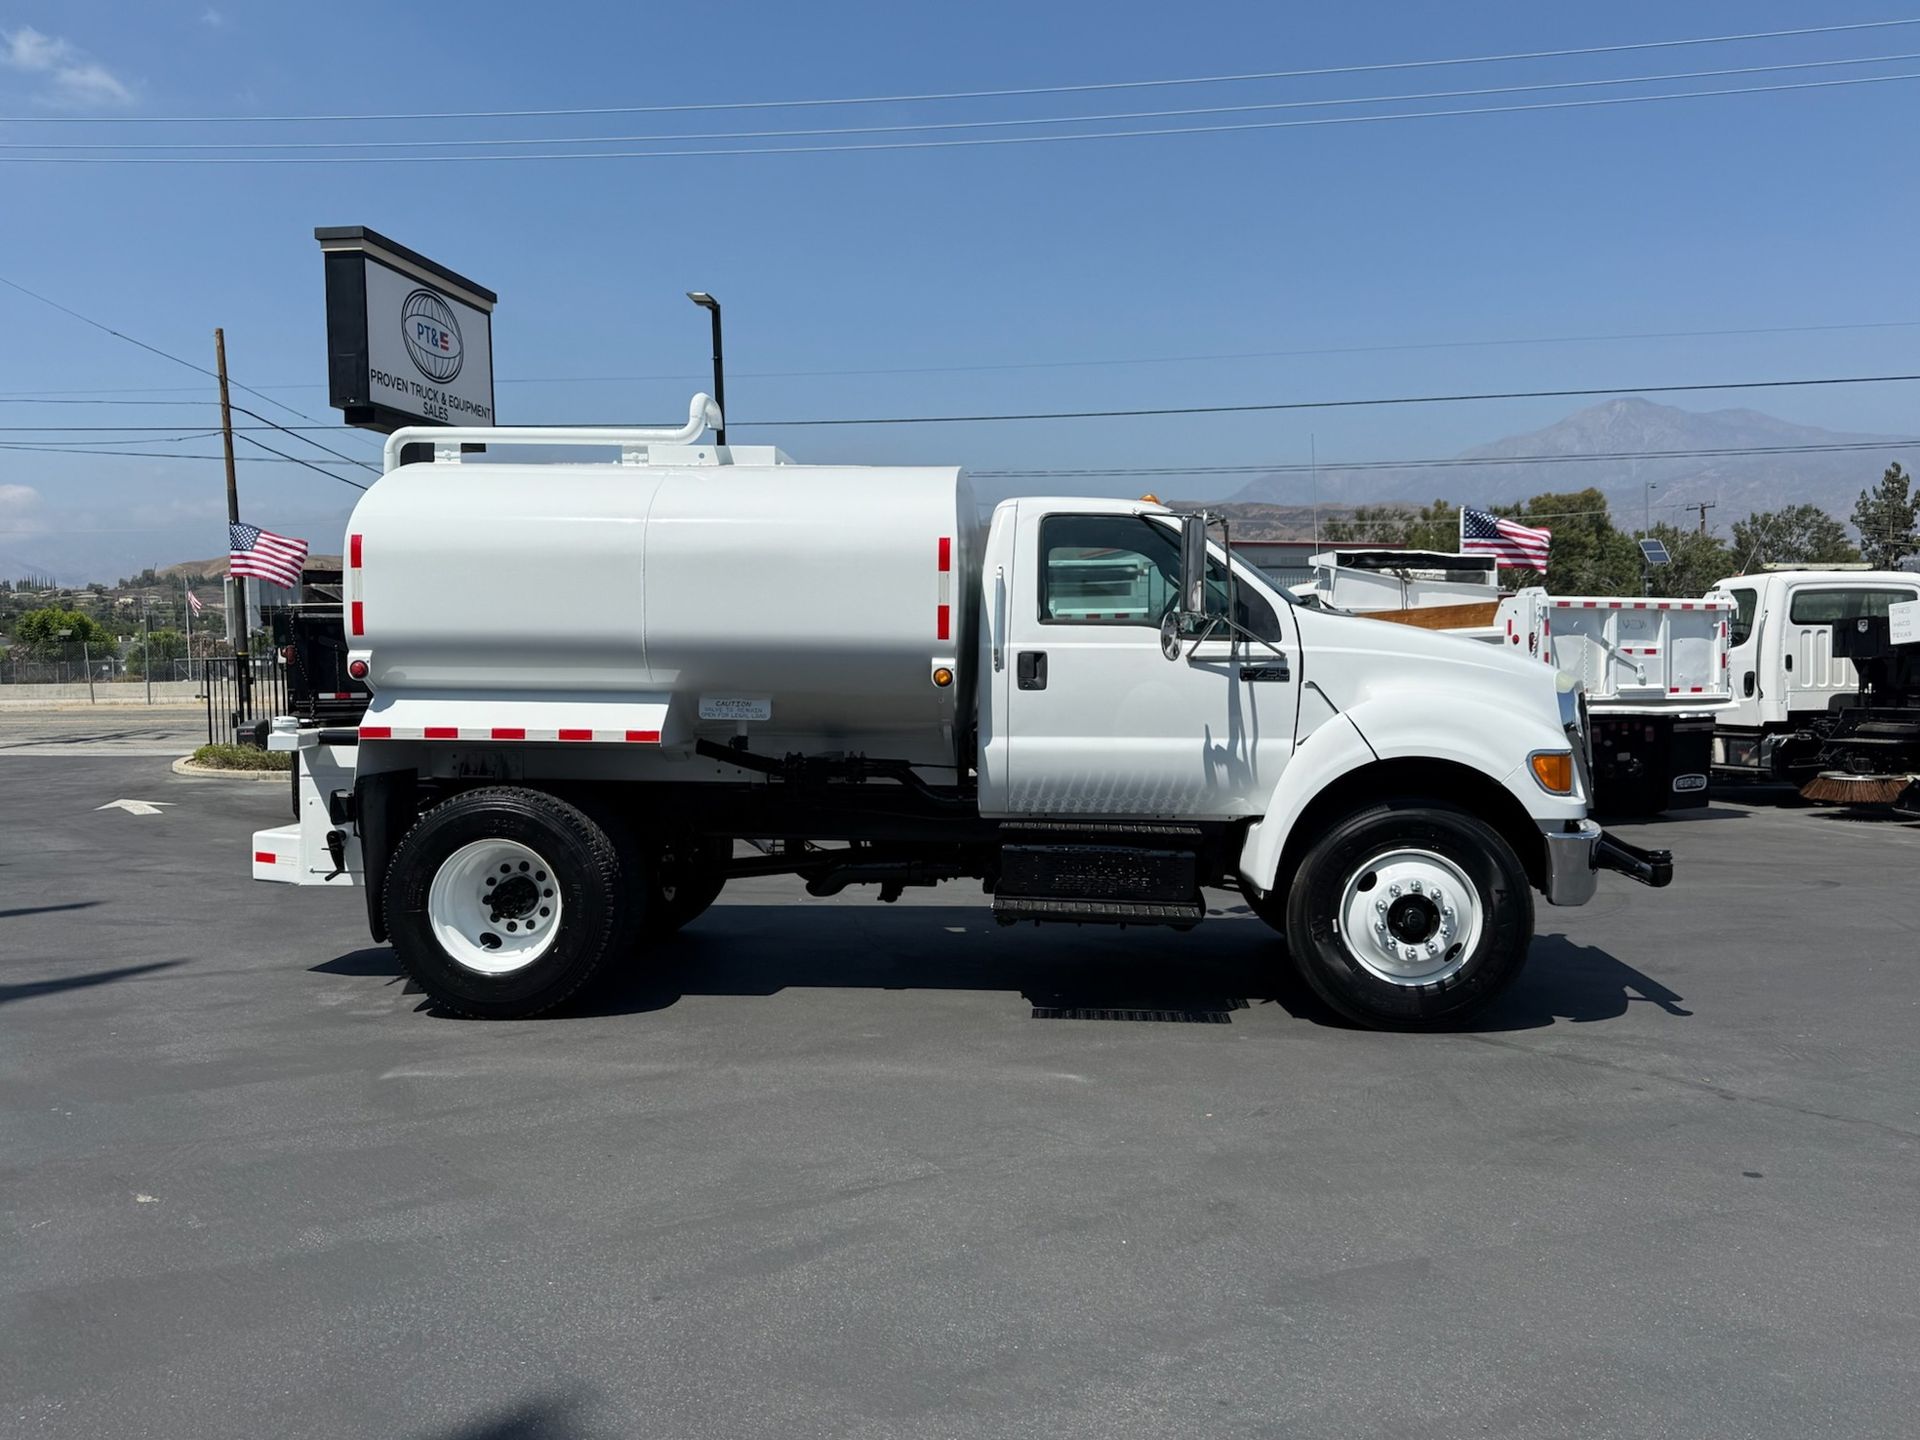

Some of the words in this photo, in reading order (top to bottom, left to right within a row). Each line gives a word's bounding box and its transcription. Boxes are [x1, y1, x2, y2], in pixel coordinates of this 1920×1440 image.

[416, 322, 449, 351] PT&E
[370, 369, 408, 394] PROVEN
[410, 381, 439, 403] TRUCK
[441, 392, 447, 406] &
[449, 395, 491, 420] EQUIPMENT
[423, 402, 449, 421] SALES
[715, 700, 752, 708] CAUTION
